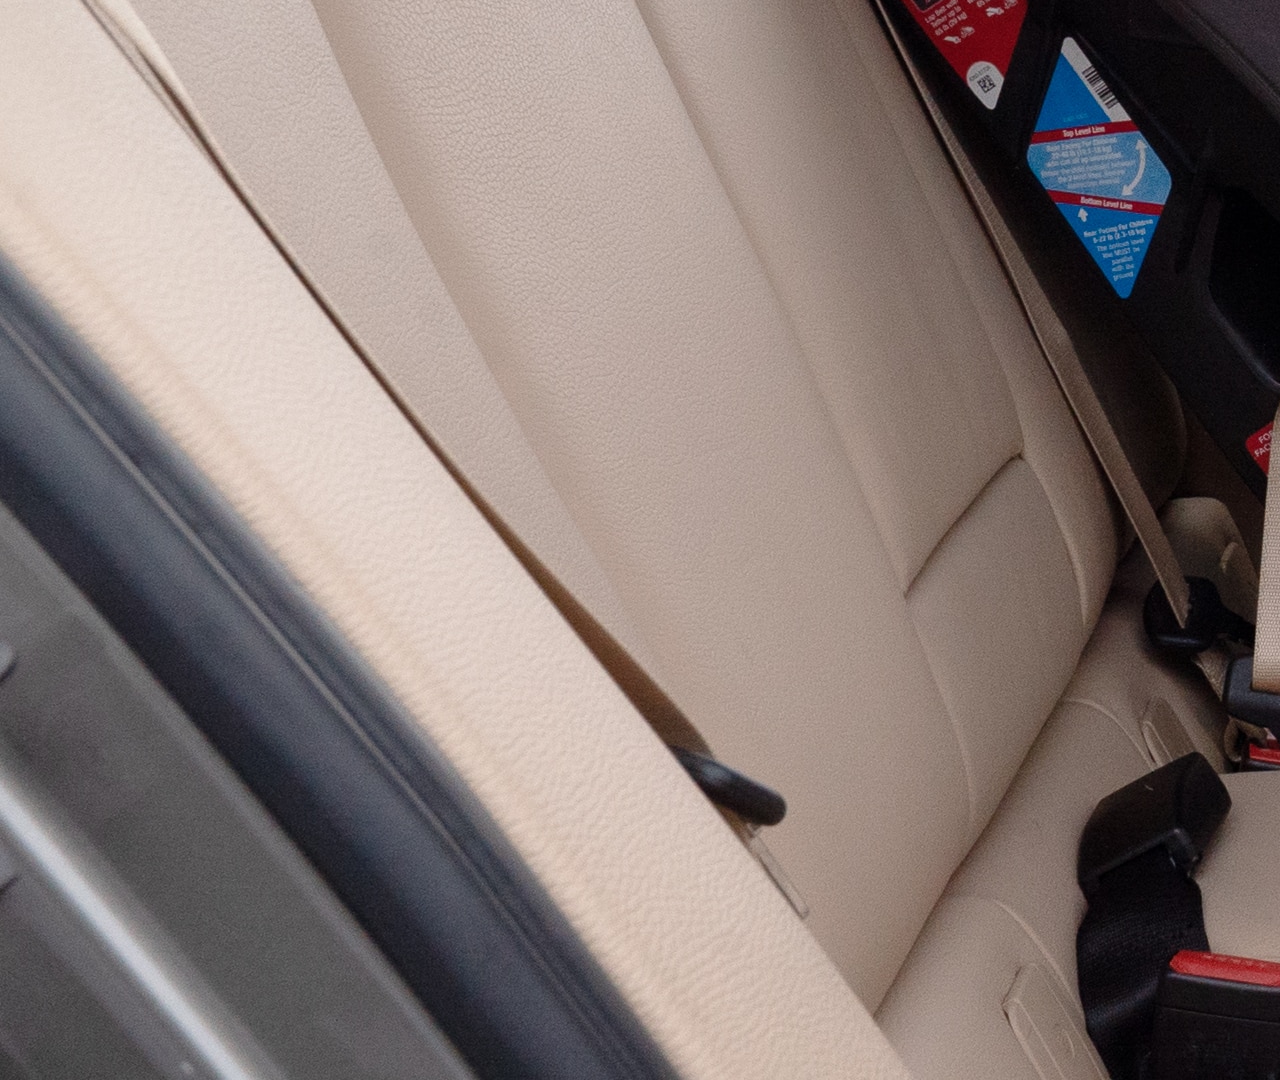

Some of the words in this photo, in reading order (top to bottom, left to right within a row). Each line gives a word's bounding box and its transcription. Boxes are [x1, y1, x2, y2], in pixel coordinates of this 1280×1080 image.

[1076, 128, 1091, 136] Level
[1093, 126, 1105, 134] Line
[1081, 197, 1102, 206] Bottom
[1104, 200, 1119, 208] Level
